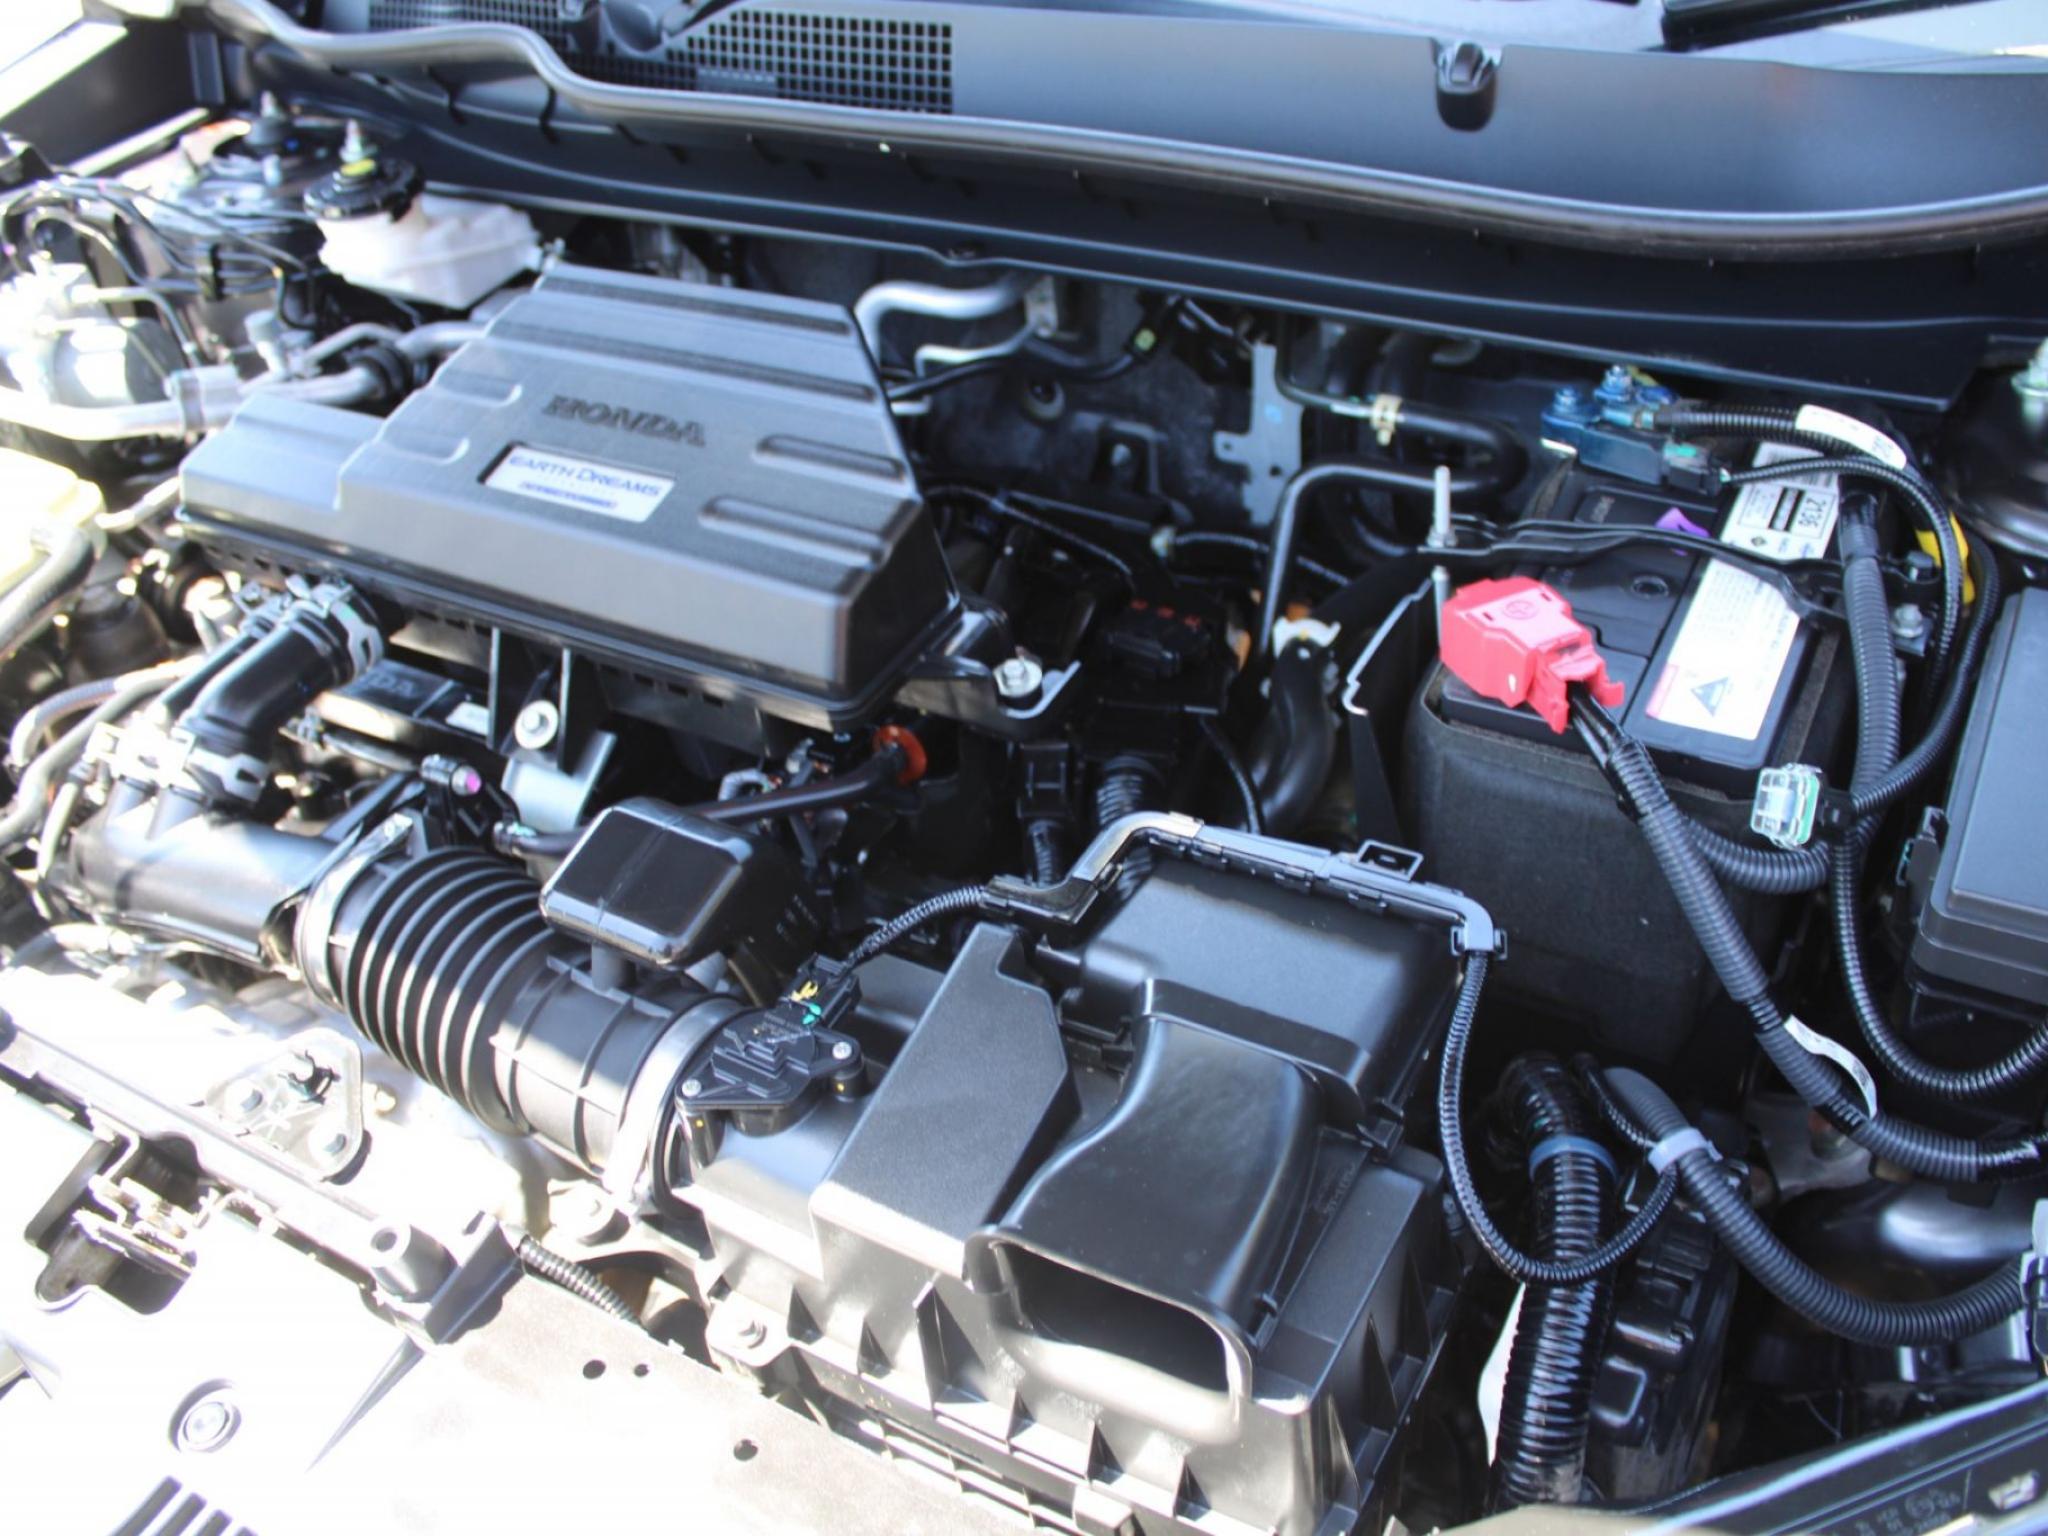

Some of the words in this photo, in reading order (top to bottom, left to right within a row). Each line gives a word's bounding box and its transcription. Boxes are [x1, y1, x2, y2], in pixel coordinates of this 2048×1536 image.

[542, 394, 706, 448] HONDA
[509, 454, 574, 478] EARTH
[576, 466, 662, 497] DREAMS
